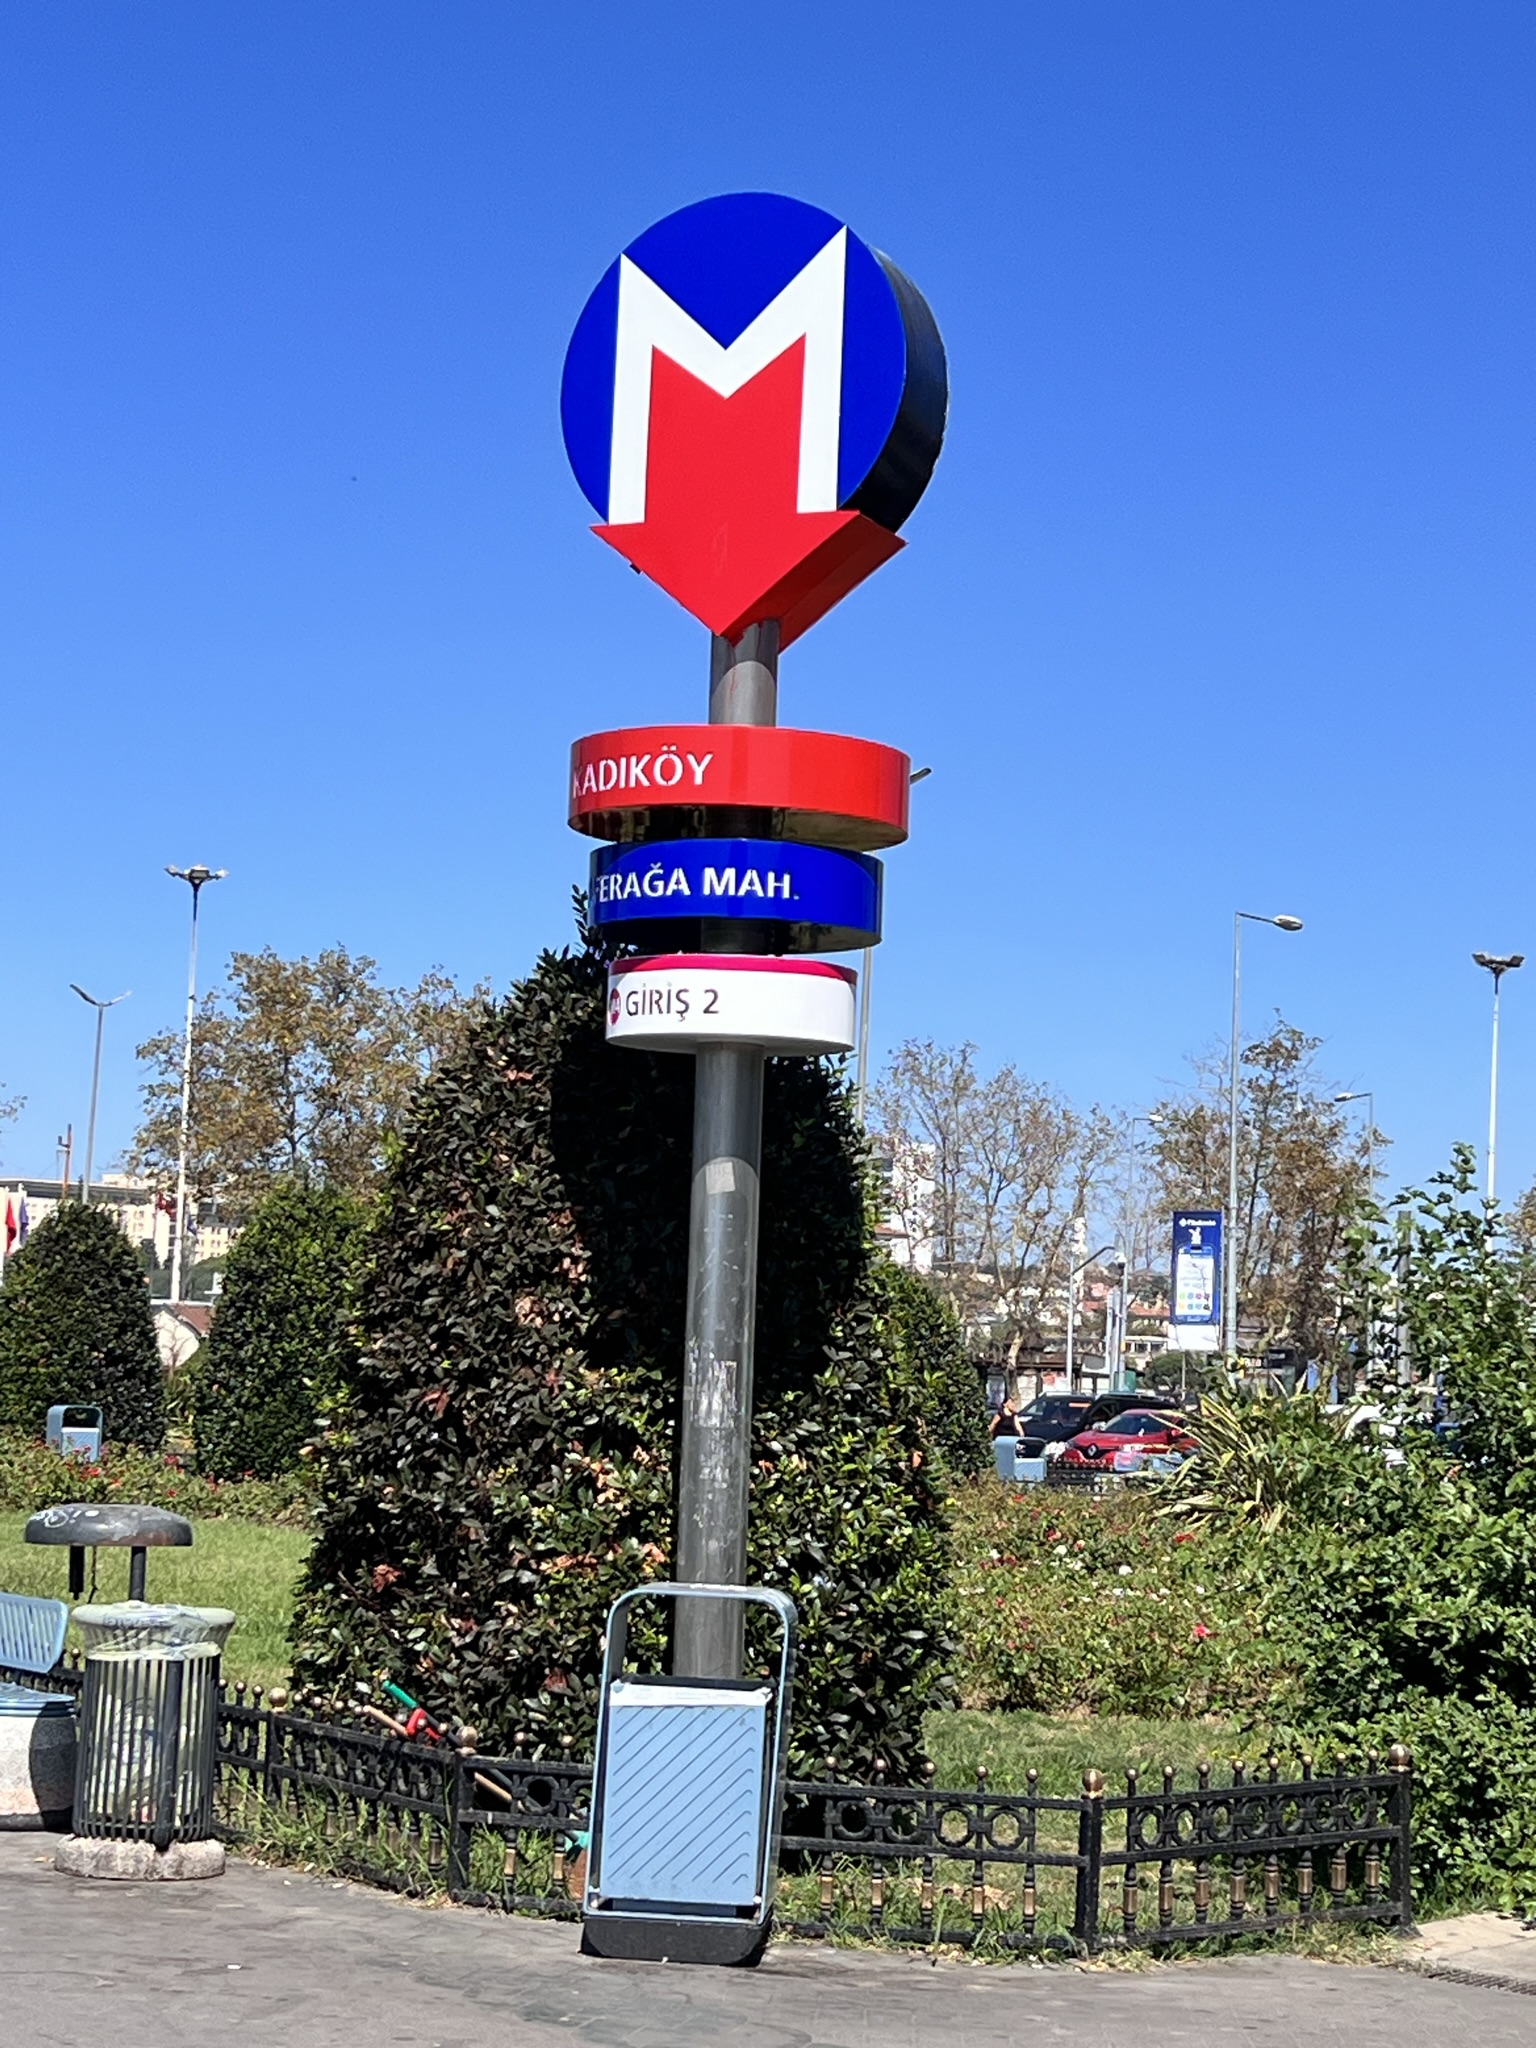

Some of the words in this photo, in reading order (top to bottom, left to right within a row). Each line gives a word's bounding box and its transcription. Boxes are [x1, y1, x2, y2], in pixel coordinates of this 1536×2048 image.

[607, 224, 847, 526] M
[703, 866, 800, 900] MAH.
[625, 981, 690, 1022] GİRİŞ
[702, 988, 719, 1014] 2
